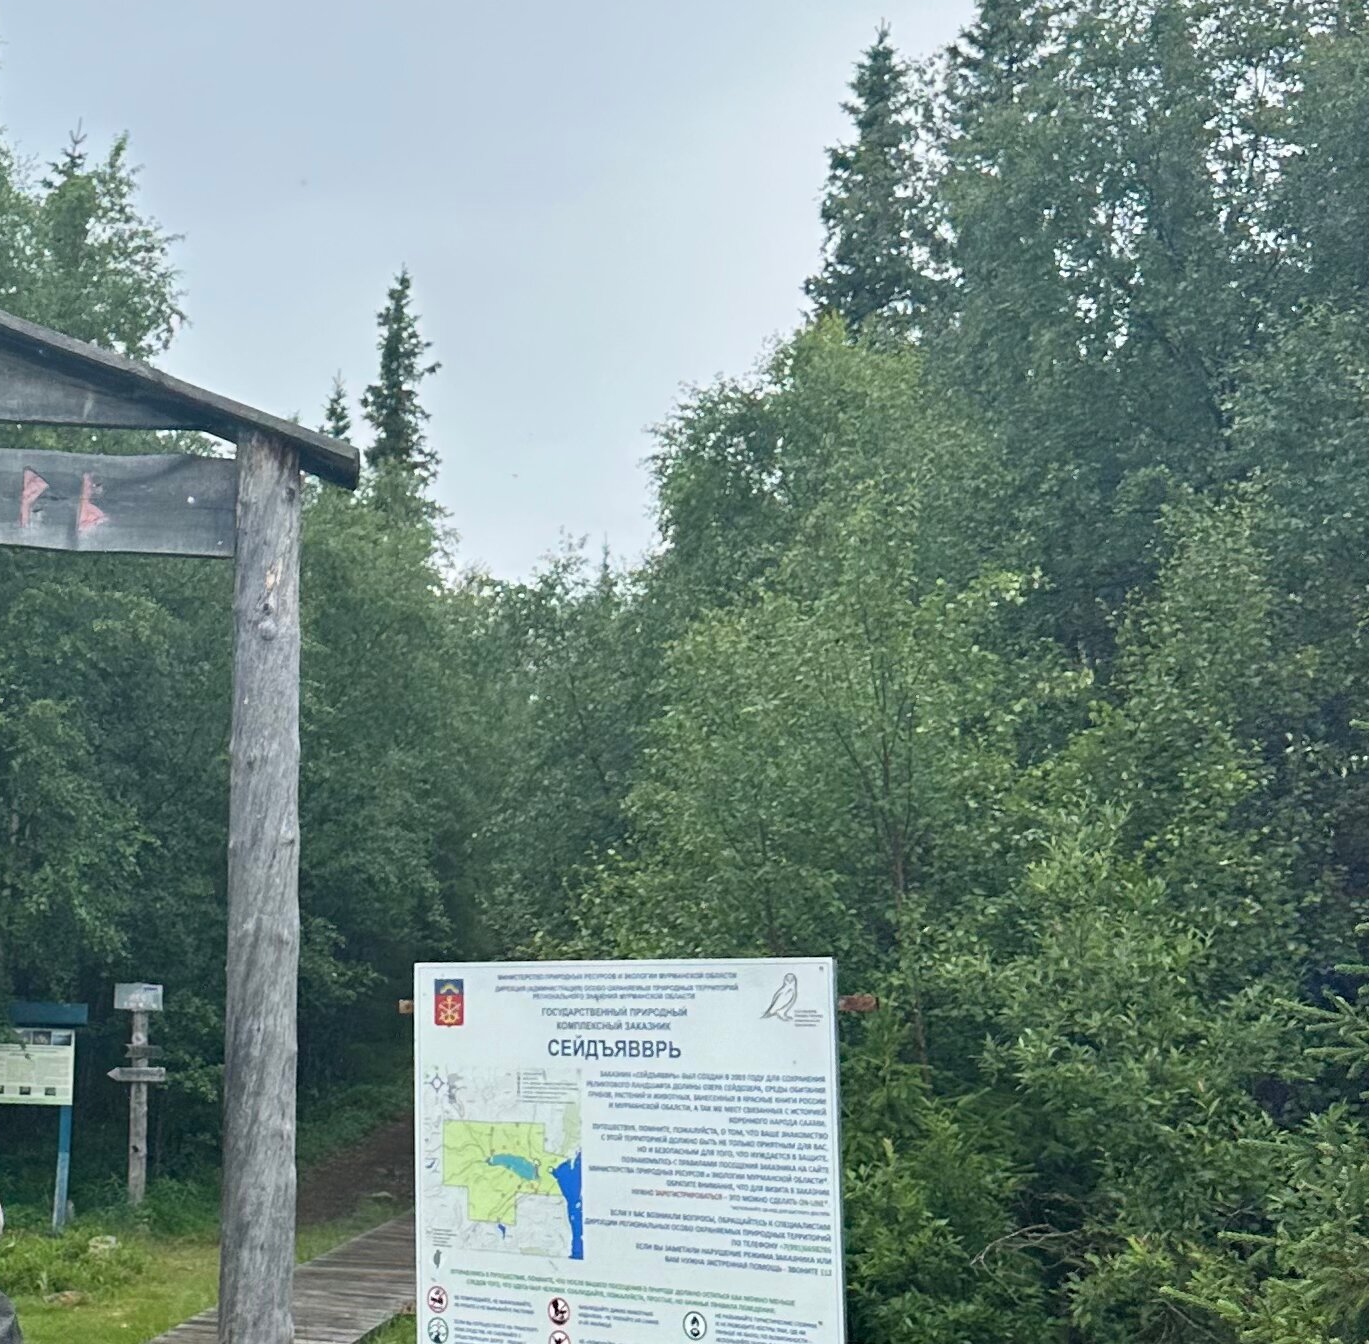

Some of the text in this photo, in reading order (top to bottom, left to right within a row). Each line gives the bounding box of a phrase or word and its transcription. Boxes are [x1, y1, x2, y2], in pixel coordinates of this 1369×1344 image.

[542, 1007, 688, 1017] ГОСУДАРСТВЕННЫЙ ПРИРОДНЫЙ
[556, 1020, 671, 1031] КОМПЛЕКСНЫЙ ЗАКАЗНИК
[548, 1035, 682, 1061] СЕЙДЪЯВВРЬ
